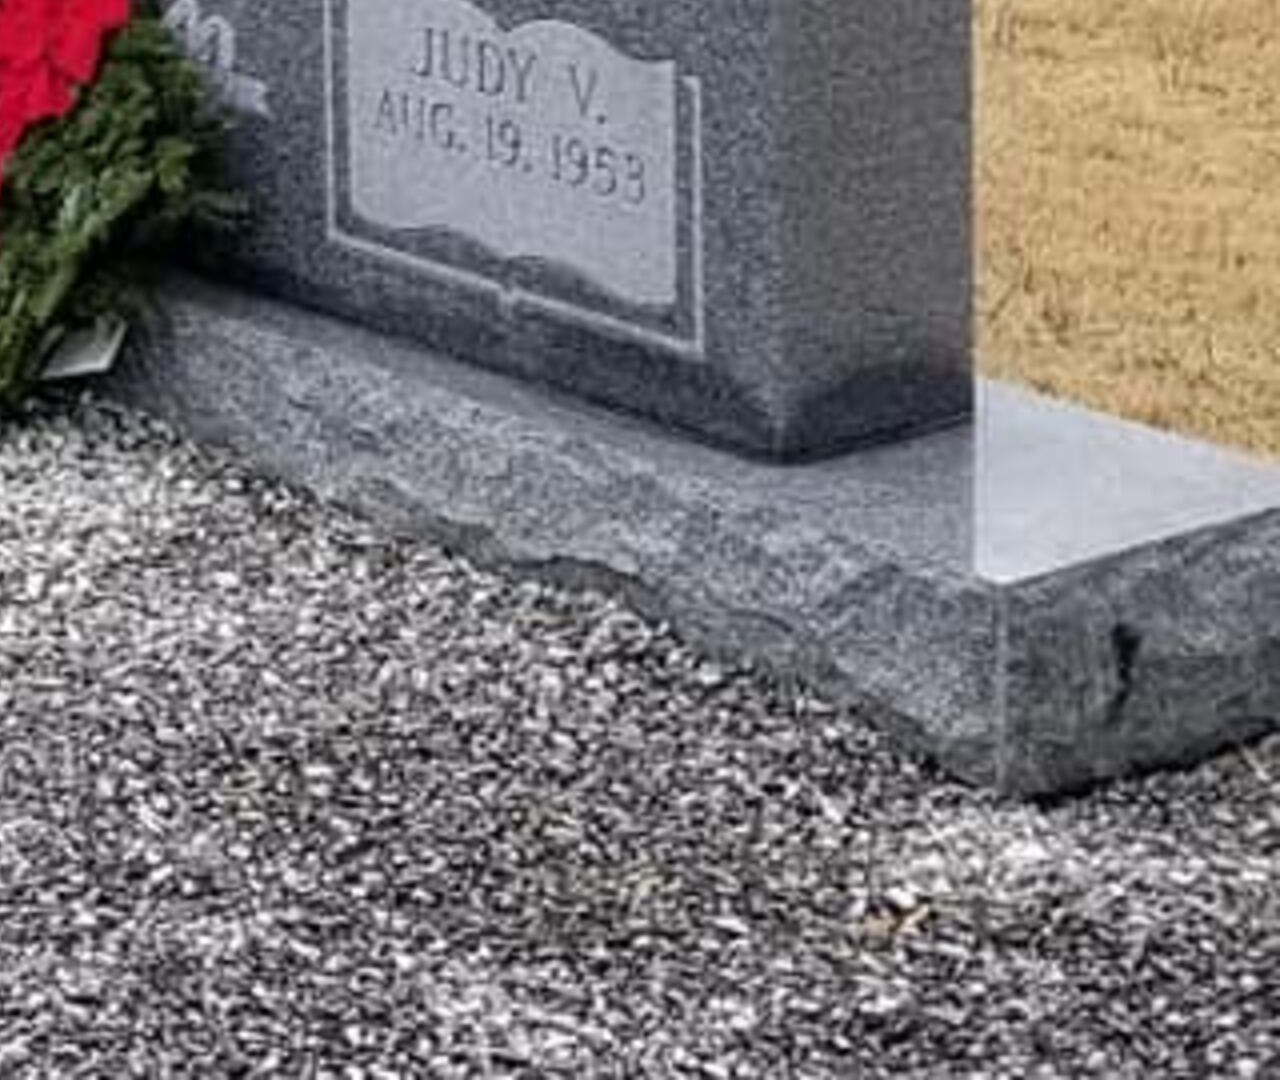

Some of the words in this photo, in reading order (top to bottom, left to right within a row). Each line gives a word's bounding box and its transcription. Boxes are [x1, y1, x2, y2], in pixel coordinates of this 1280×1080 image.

[411, 26, 537, 103] JUDY
[567, 59, 607, 126] V.
[373, 88, 467, 153] AUG.
[552, 133, 646, 206] 1953
